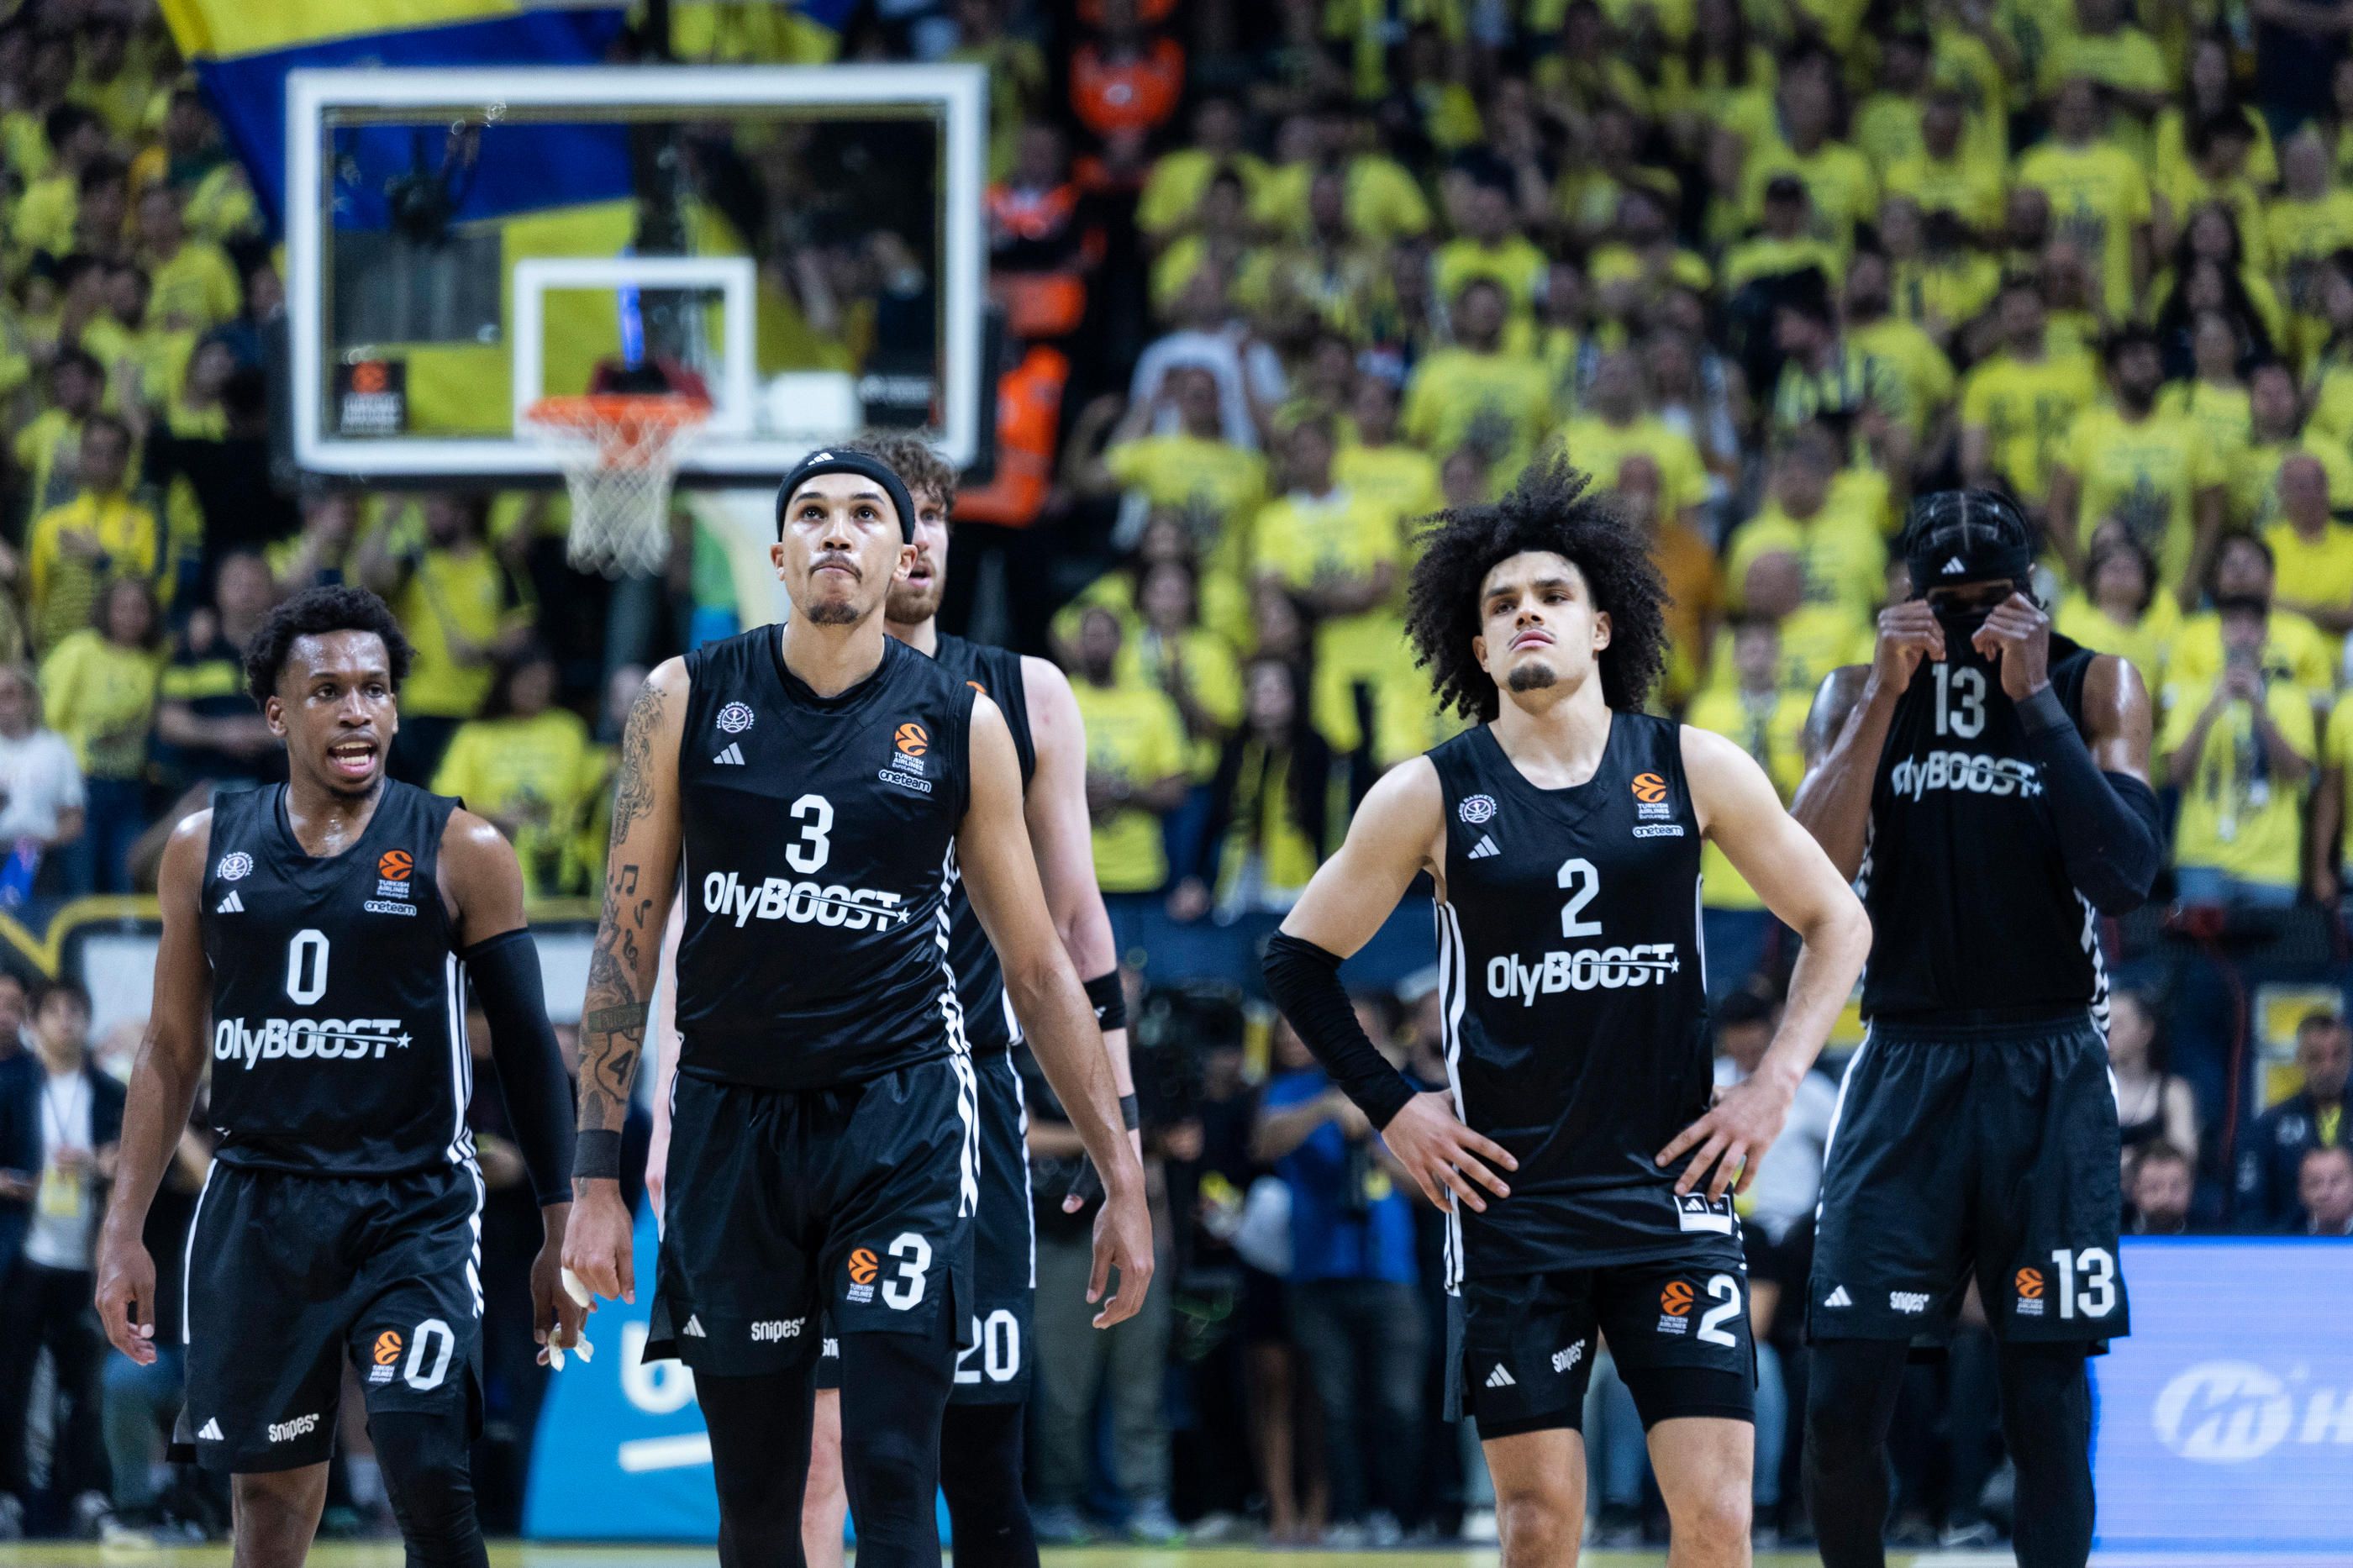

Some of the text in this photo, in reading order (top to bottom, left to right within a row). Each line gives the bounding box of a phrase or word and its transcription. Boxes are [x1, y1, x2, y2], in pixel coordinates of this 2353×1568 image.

[1932, 662, 1987, 739] 13
[878, 769, 932, 793] oneteam
[892, 757, 924, 771] AIRLINES
[894, 751, 924, 766] TURKISH
[785, 793, 834, 875] 3
[1633, 823, 1684, 838] oneteam
[364, 900, 417, 917] oneteam
[377, 885, 409, 893] AIRLINES
[378, 879, 410, 887] TURKISH
[703, 871, 903, 932] OlyBOOST
[1557, 857, 1603, 939] 2
[287, 929, 330, 1006] 0
[1487, 943, 1676, 1008] OlyBOOST
[214, 1017, 403, 1071] OlyBOOST
[882, 1232, 933, 1311] 3
[2051, 1247, 2116, 1319] 13
[750, 1318, 801, 1343] snipes
[1696, 1274, 1741, 1348] 2
[404, 1318, 455, 1391] 0
[268, 1414, 315, 1443] snipes
